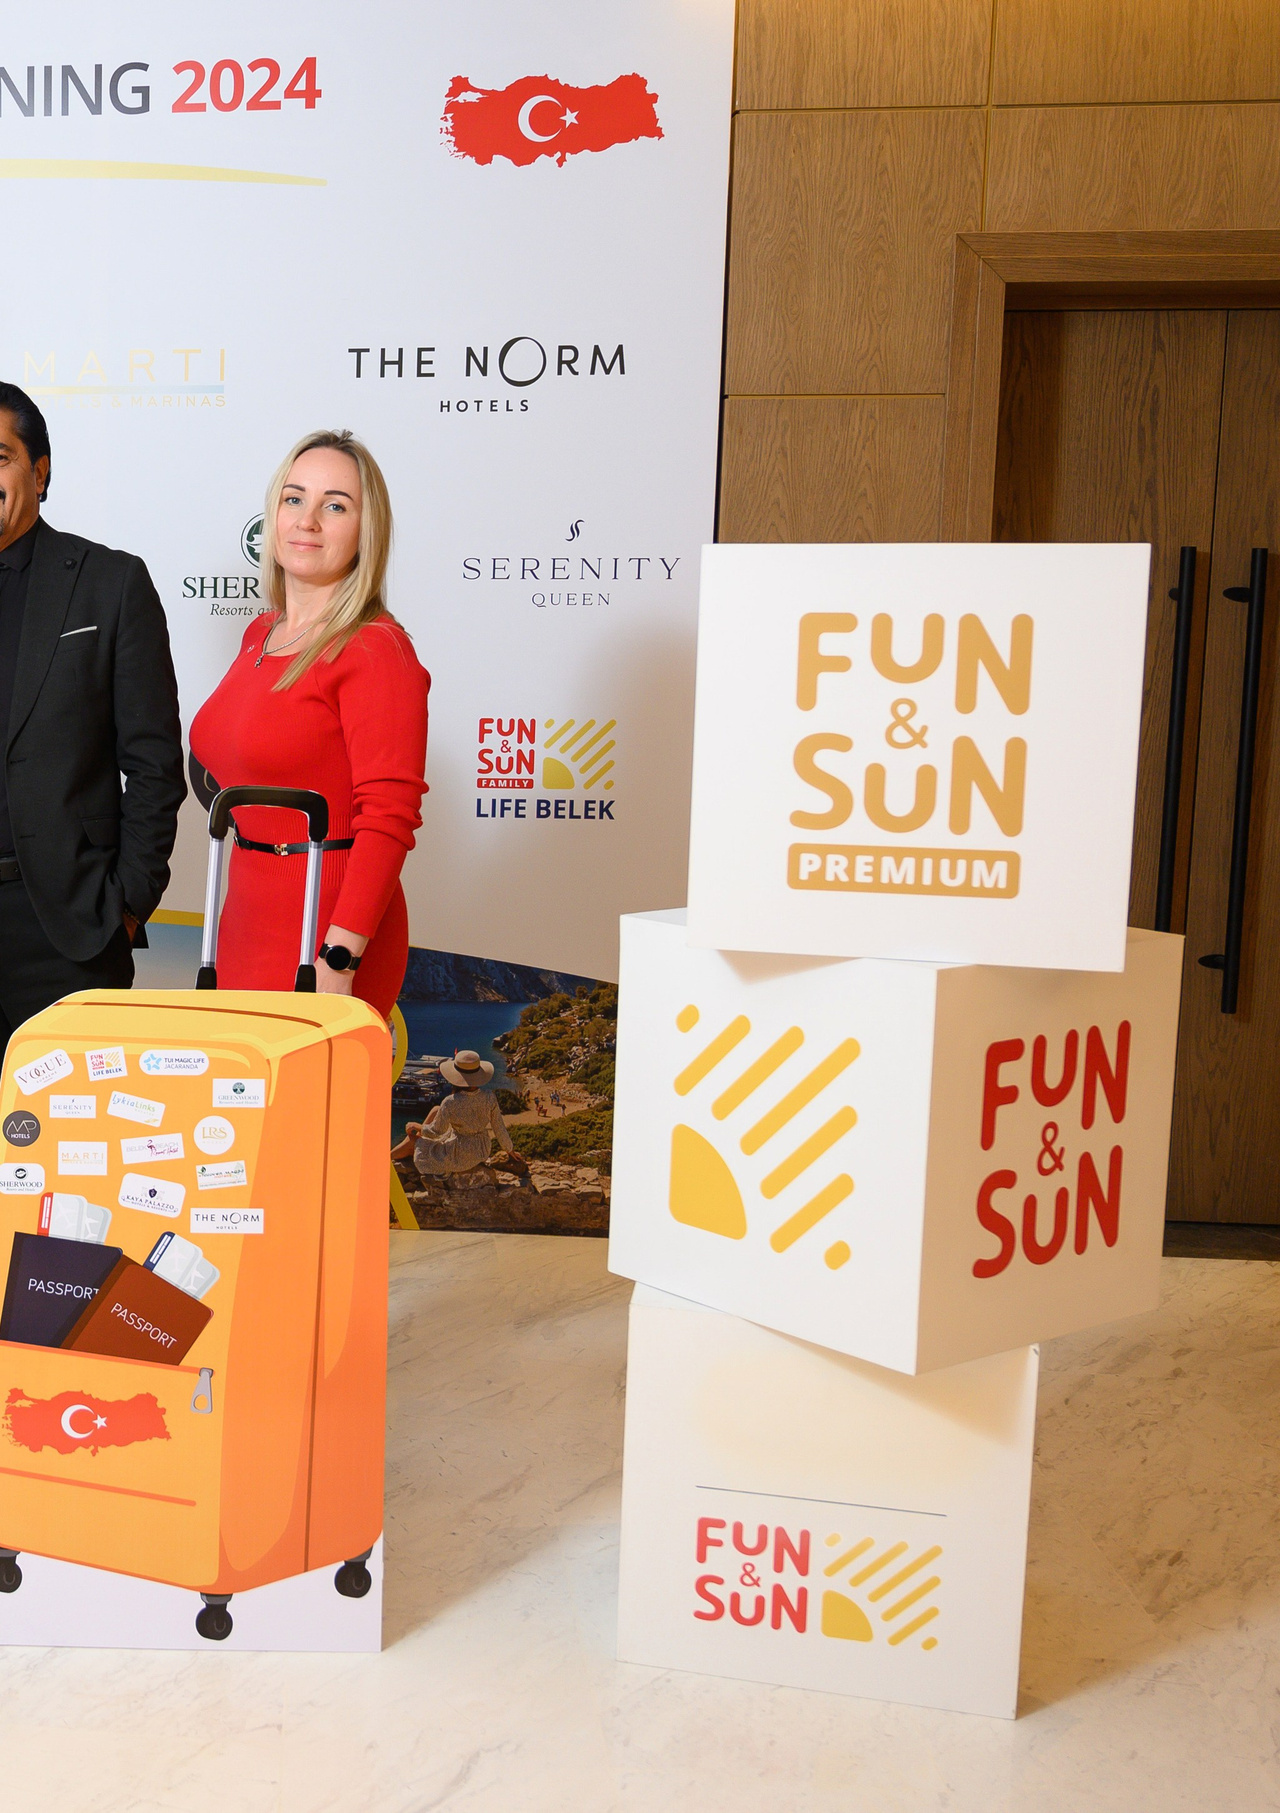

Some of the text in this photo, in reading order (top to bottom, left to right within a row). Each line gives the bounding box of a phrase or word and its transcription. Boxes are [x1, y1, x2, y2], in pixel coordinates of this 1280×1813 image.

[171, 56, 322, 113] 2024
[23, 348, 225, 383] MARTI
[348, 336, 626, 387] THE NORM
[37, 396, 101, 409] OTELS
[130, 394, 227, 408] MARINAS
[440, 399, 529, 413] HOTELS
[462, 557, 681, 580] SERENITY
[182, 576, 262, 599] SHER
[531, 593, 611, 608] QUEEN
[210, 603, 253, 616] Resorts
[795, 611, 1034, 716] FUN
[478, 717, 536, 744] FUN
[884, 697, 929, 750] &
[500, 739, 512, 753] &
[477, 748, 535, 775] SUN
[481, 779, 529, 788] FAMILY
[788, 731, 1028, 838] SUN
[476, 798, 615, 820] LIFE BELEK
[798, 852, 1009, 889] PREMIUM
[18, 1054, 67, 1084] VOGUE
[105, 1067, 123, 1075] BELEK
[980, 1019, 1132, 1151] FUN
[1036, 1120, 1065, 1177] &
[126, 1194, 175, 1210] KAYA PALAZZO
[971, 1144, 1123, 1280] SUN
[195, 1212, 260, 1224] THE NORM
[110, 1302, 178, 1349] PASSPORT
[696, 1516, 810, 1577] FUN
[739, 1562, 761, 1588] &
[693, 1574, 808, 1634] SUN
